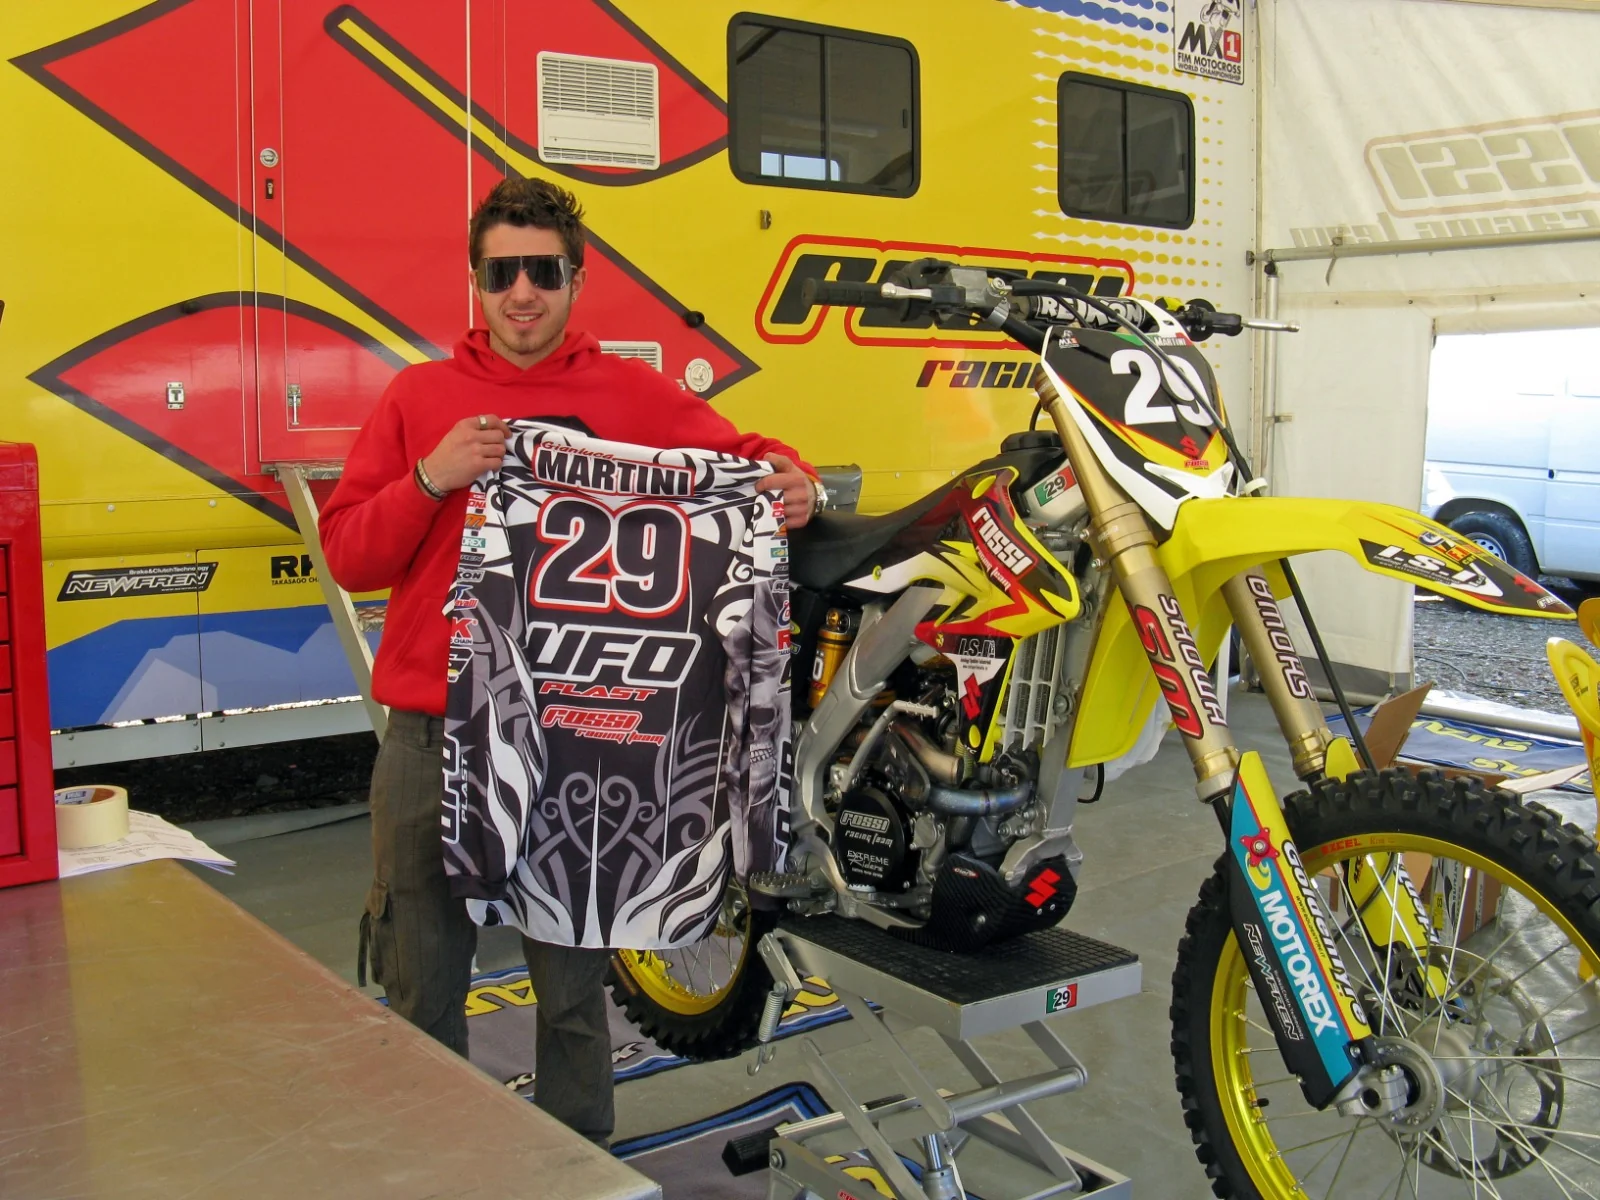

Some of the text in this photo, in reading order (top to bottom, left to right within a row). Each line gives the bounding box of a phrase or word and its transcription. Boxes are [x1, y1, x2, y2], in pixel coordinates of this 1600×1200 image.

[1178, 21, 1241, 63] MX1
[1177, 52, 1241, 75] FIM MOTOCROSS
[1177, 63, 1241, 81] WORLD CHAMPIONSHIP
[1155, 336, 1187, 347] MARTINI
[1110, 349, 1214, 427] 29
[541, 441, 615, 461] Gianluca
[537, 449, 690, 496] MARTINI
[1043, 476, 1067, 499] 29
[534, 497, 687, 613] 29
[66, 572, 209, 597] NEWFREN
[272, 577, 307, 585] TAKASAGO
[1246, 575, 1315, 702] SHOWA
[526, 621, 702, 688] UFO
[1158, 594, 1228, 728] SHOWA
[539, 681, 658, 701] PLAST
[575, 729, 667, 746] racing team
[845, 830, 894, 848] racing team
[847, 850, 889, 866] EXTREME
[1282, 839, 1368, 1026] Goldentyre
[1260, 889, 1339, 1037] MOTOREX
[1243, 923, 1300, 1041] NEWFREN
[1052, 990, 1071, 1009] 29
